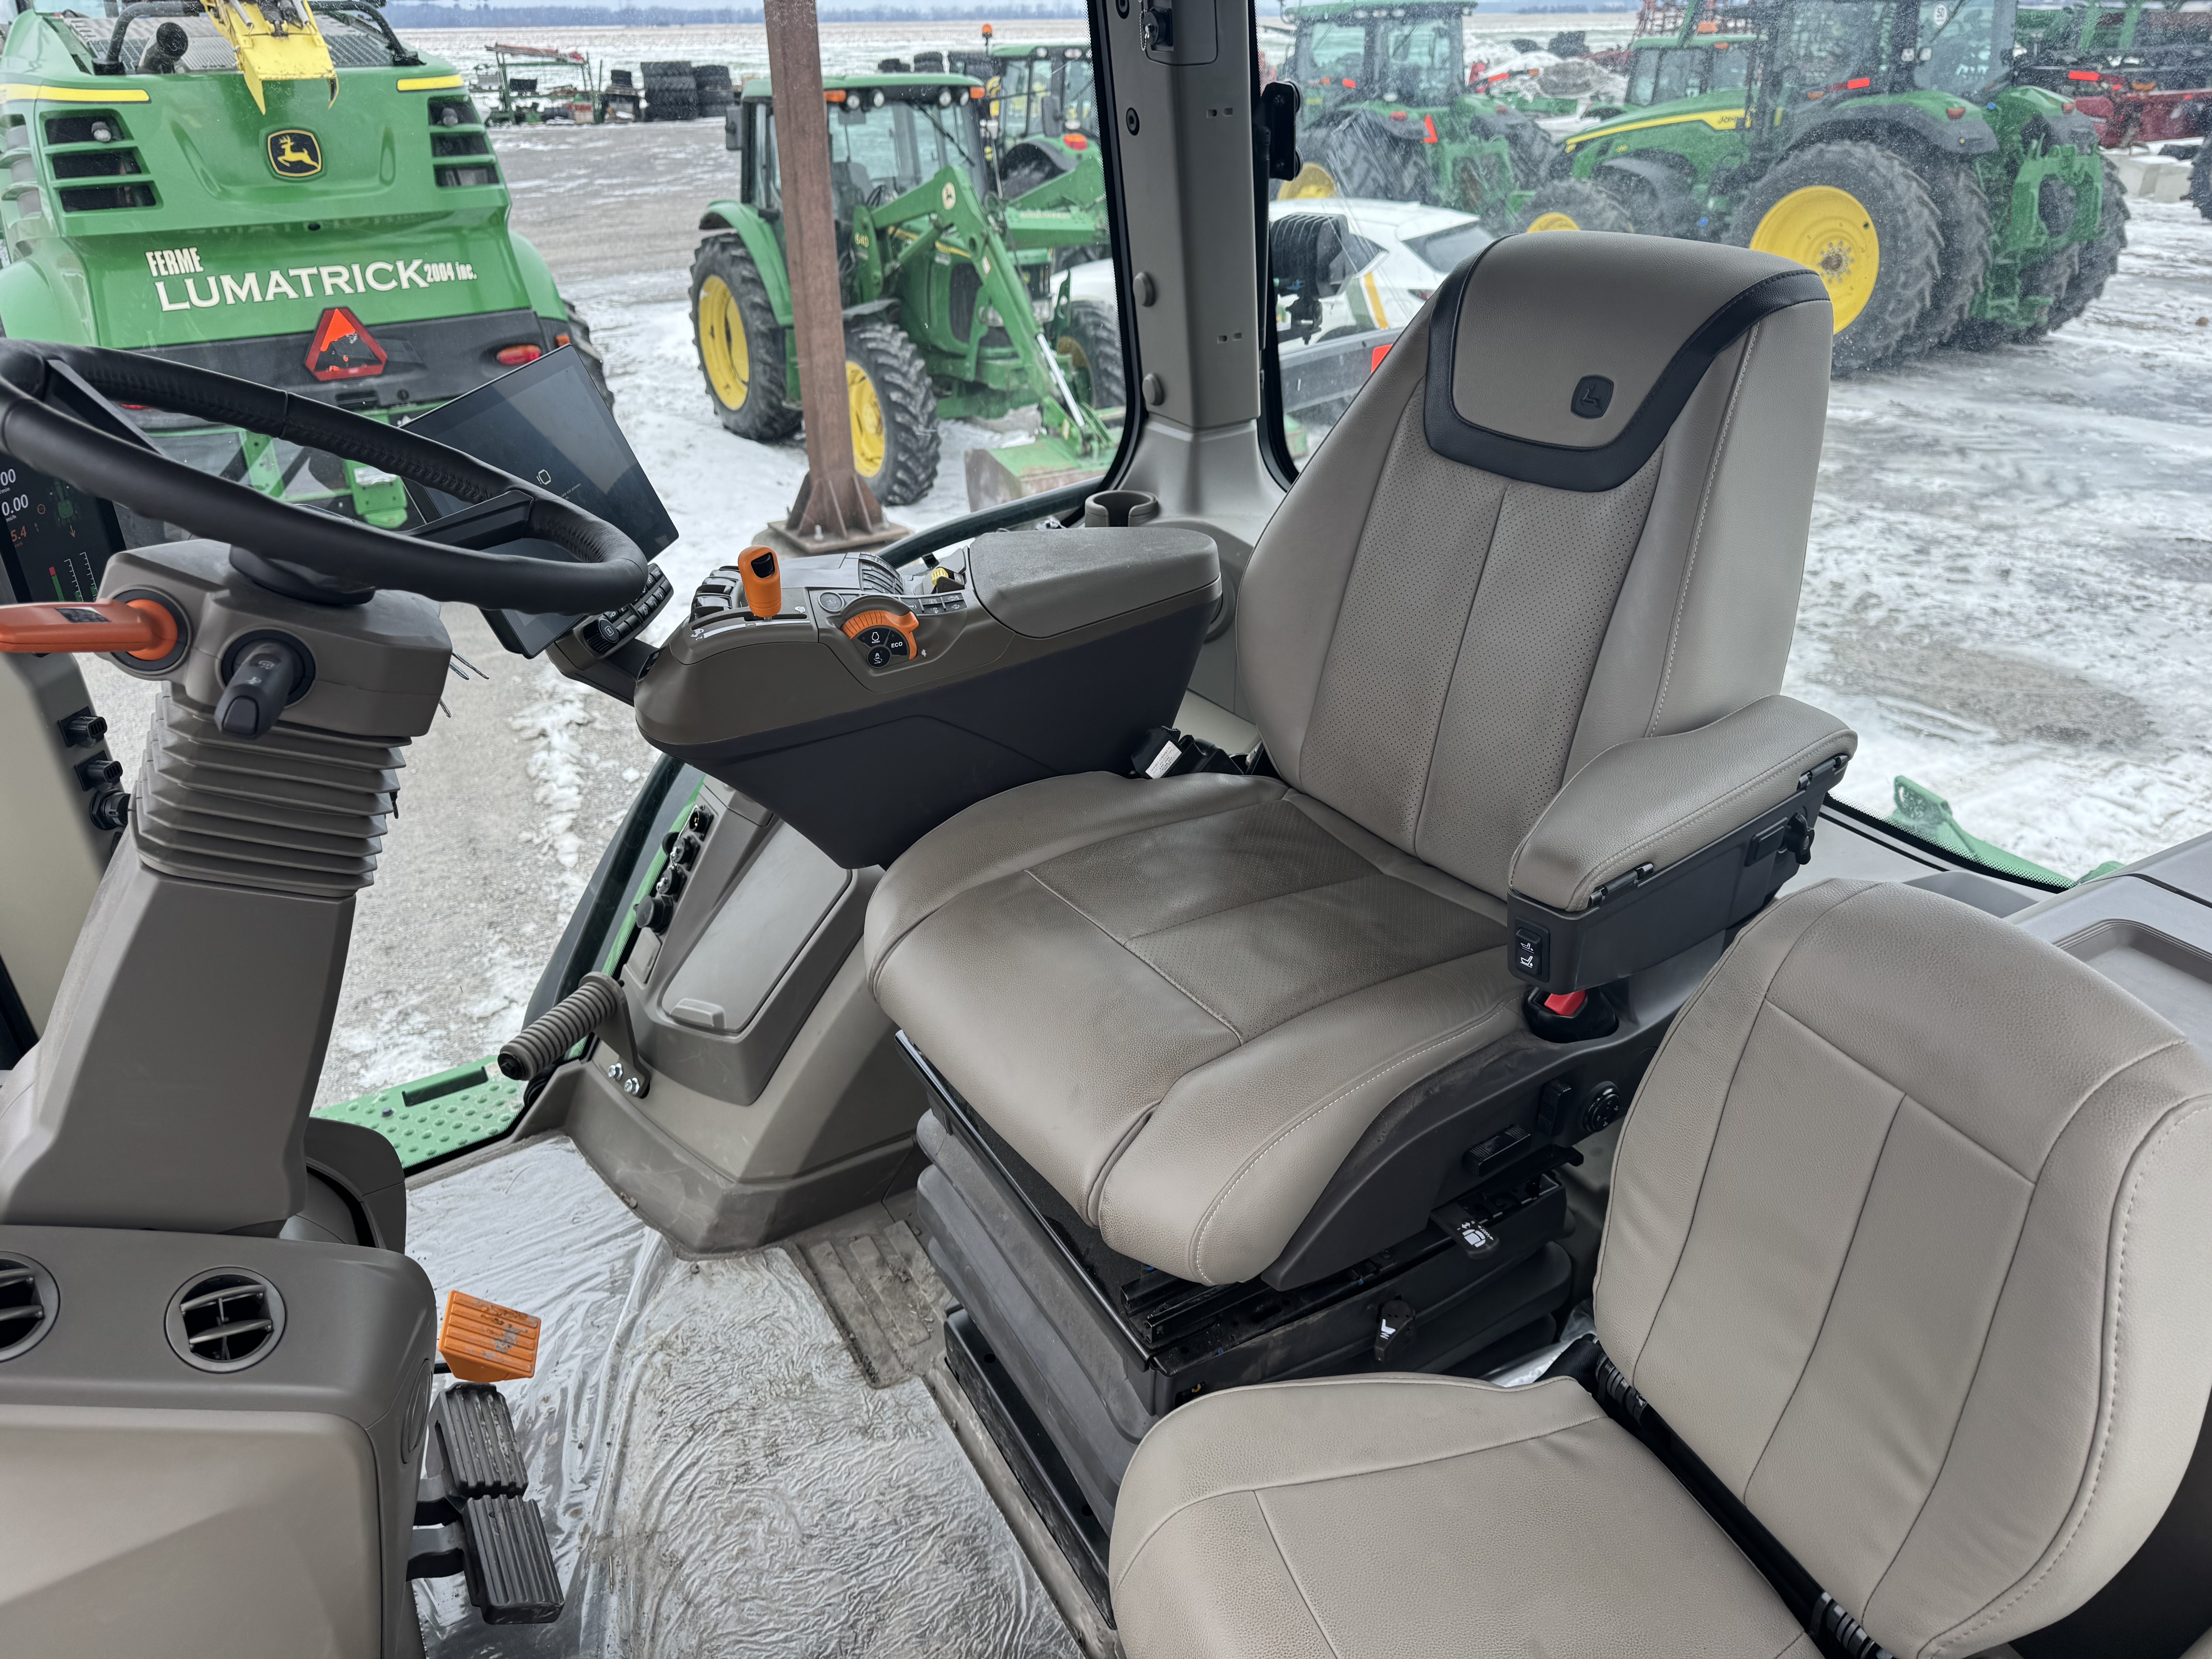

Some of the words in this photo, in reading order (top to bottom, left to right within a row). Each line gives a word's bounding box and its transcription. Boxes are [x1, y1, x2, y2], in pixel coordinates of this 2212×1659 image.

[145, 247, 204, 276] FERME
[155, 259, 430, 311] LUMATRICK
[423, 262, 455, 283] 2004
[455, 261, 477, 281] inc.
[2, 494, 29, 516] 0.00
